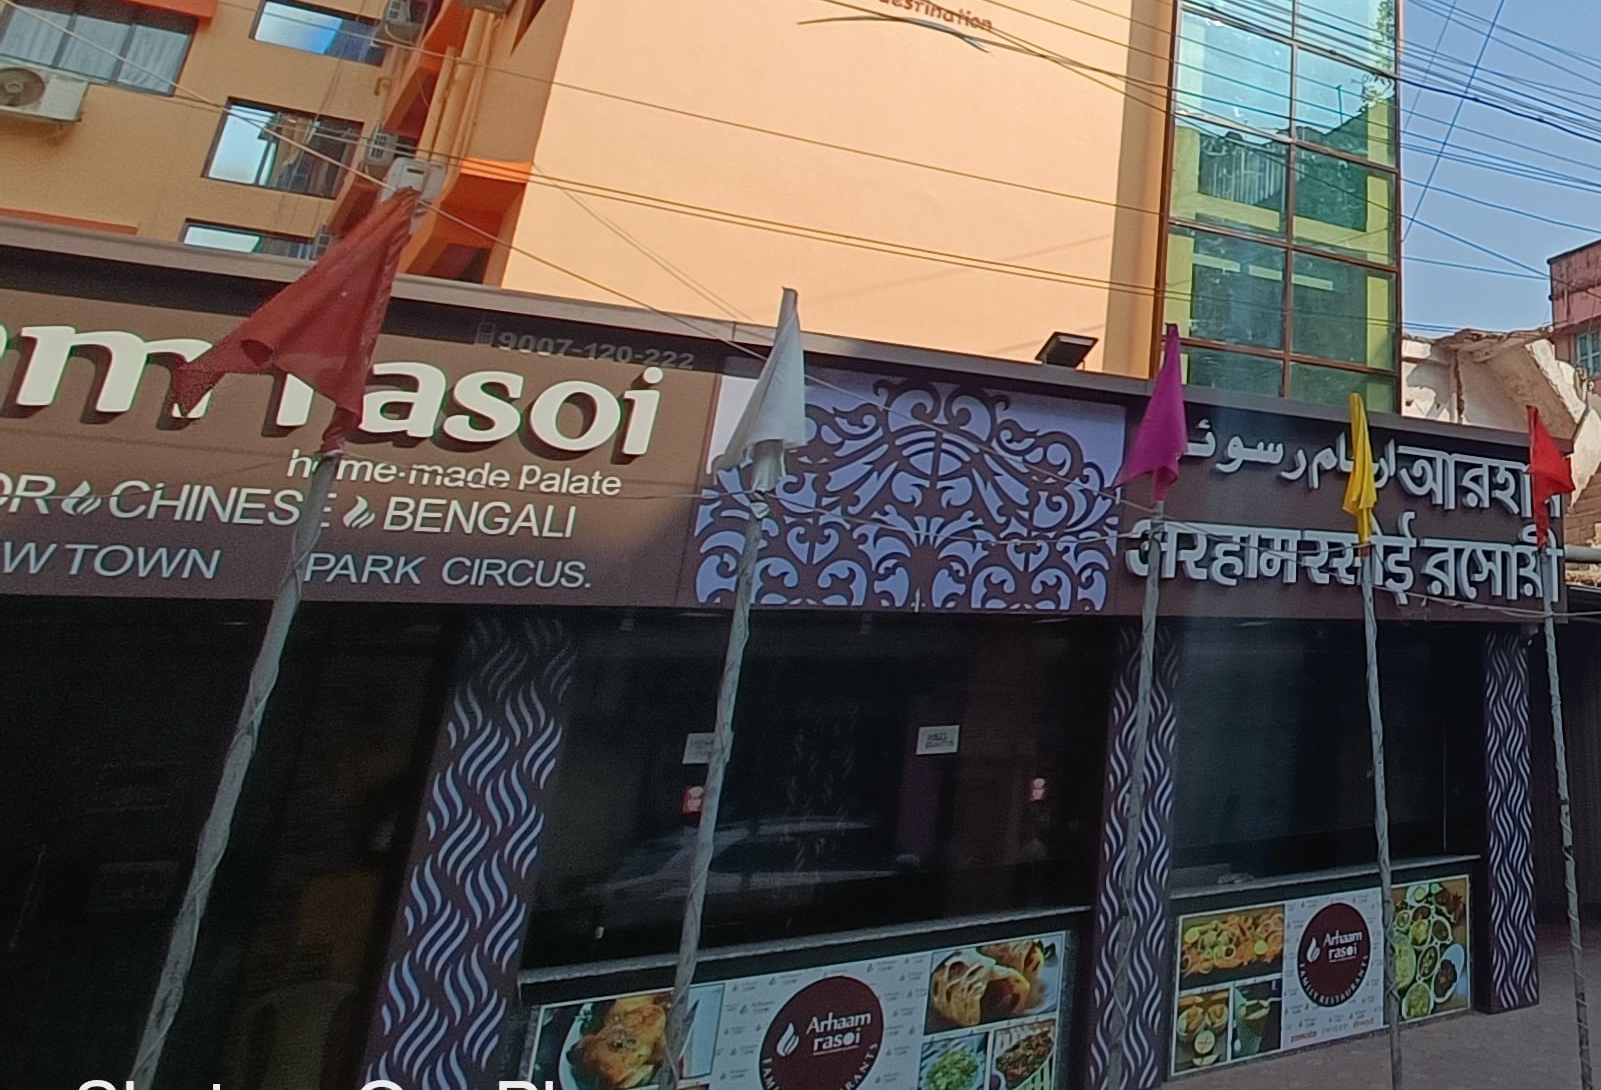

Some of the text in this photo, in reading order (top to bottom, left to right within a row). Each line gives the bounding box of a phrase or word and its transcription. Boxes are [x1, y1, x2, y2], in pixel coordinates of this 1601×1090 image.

[499, 331, 696, 369] 9007-120-222
[286, 449, 511, 489] hme-made
[1396, 445, 1562, 518] আরহা
[109, 479, 338, 528] CHINES
[383, 496, 577, 538] BENGALI
[64, 543, 222, 579] TOWN
[303, 552, 426, 585] PARK
[440, 556, 592, 588] CIRCUS.
[1322, 929, 1363, 948] Arhaam
[1328, 941, 1358, 959] rasoi
[805, 1011, 872, 1036] Arhaam
[813, 1027, 861, 1051] rasoi
